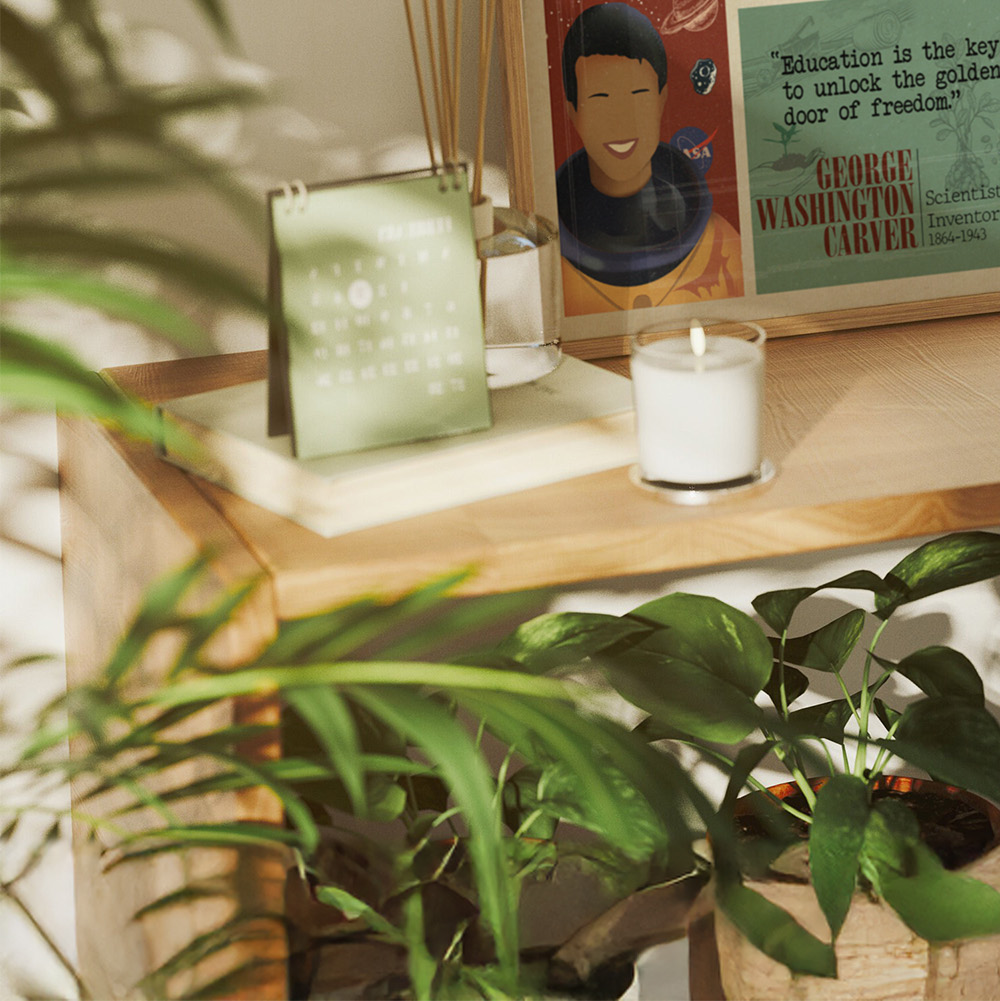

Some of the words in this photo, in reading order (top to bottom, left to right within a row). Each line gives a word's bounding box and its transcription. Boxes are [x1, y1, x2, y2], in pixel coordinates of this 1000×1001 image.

[770, 50, 883, 76] “Education
[892, 45, 912, 63] is
[921, 40, 955, 61] the
[965, 38, 1000, 59] key
[782, 81, 804, 100] to
[814, 73, 882, 97] unlock
[891, 68, 926, 89] the
[784, 106, 829, 126] door
[838, 99, 861, 121] of
[871, 89, 961, 118] freedom.”
[682, 145, 712, 160] ASA
[816, 148, 914, 191] GEORGE
[756, 182, 915, 231] WASHINGTON
[927, 207, 1000, 228] Inventor
[823, 216, 919, 258] CARVER
[928, 227, 987, 246] 1864-1943
